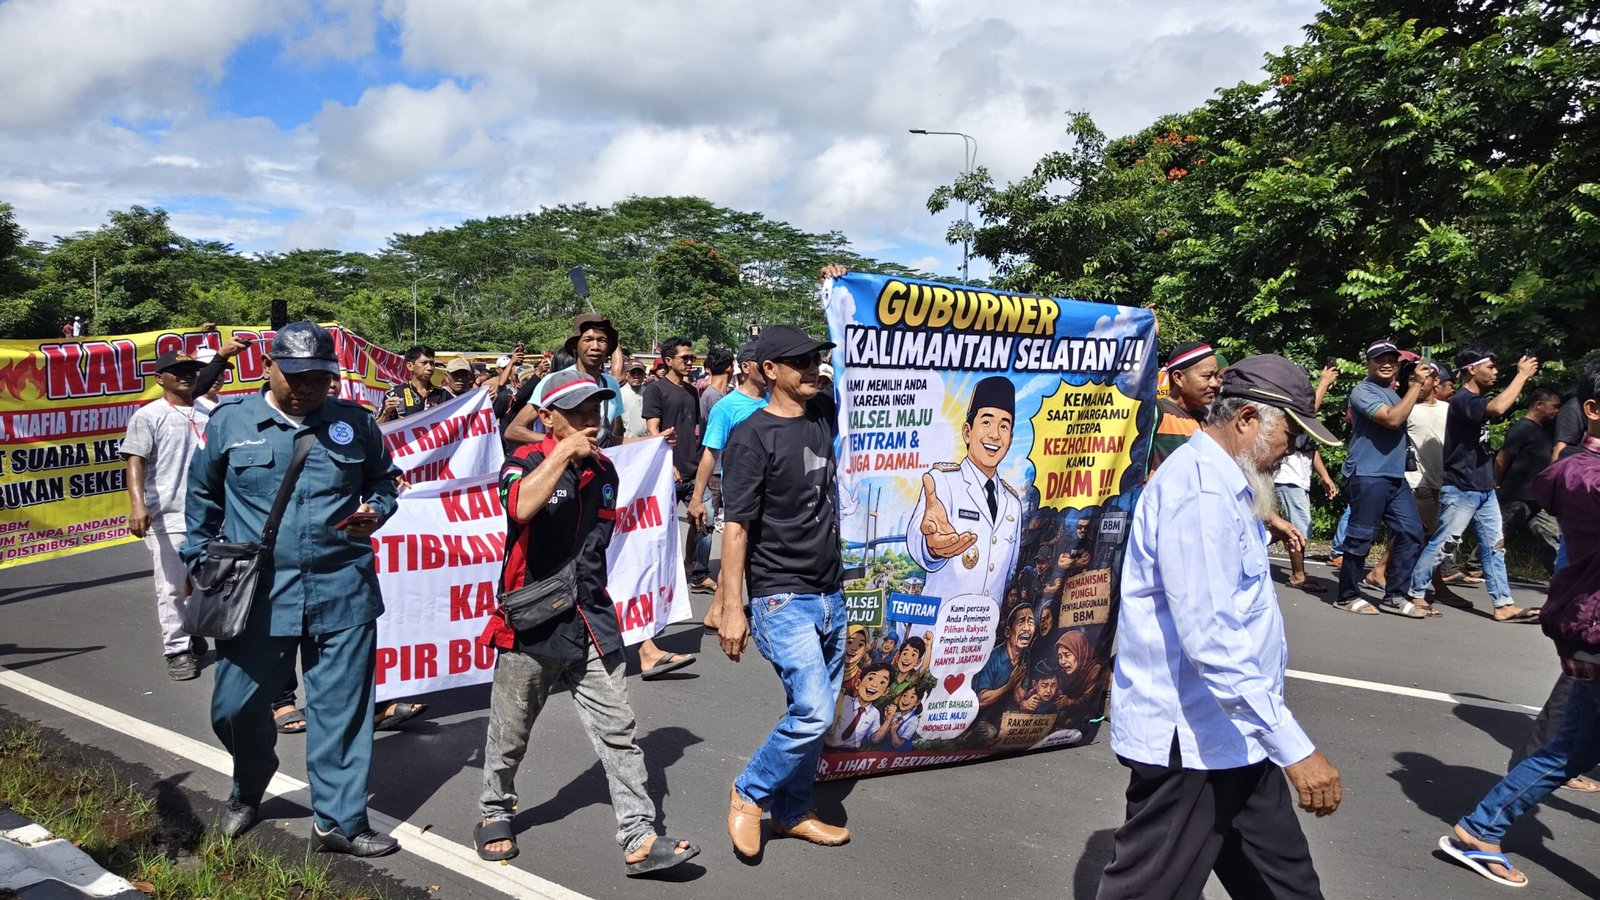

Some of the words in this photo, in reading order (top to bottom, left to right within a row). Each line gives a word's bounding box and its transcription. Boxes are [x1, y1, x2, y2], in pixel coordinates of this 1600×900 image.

[877, 280, 1060, 335] GUBURNER
[845, 328, 1013, 369] KALIMANTAN
[1014, 336, 1118, 371] SELATAN
[866, 379, 902, 391] MEMILIH
[904, 379, 927, 391] ANDA
[853, 394, 890, 407] KARENA
[892, 394, 916, 406] INGIN
[1063, 392, 1114, 407] KEMANA
[848, 410, 892, 429] KALSEL
[896, 408, 933, 427] MAJU
[1047, 409, 1075, 421] SAAT
[1077, 409, 1130, 420] WARGAMU
[13, 411, 67, 439] MAFIA
[1066, 422, 1101, 435] DITERPA
[849, 431, 907, 453] TENTRAM
[909, 430, 920, 449] &
[1043, 436, 1125, 456] KEZHOLIMAN
[11, 443, 91, 474] SUARA
[874, 452, 929, 472] DAMAI...
[1065, 456, 1096, 468] KAMU
[1045, 470, 1093, 500] DIAM
[1098, 468, 1116, 497] !!!
[0, 520, 30, 533] BBM
[20, 528, 63, 543] TANPA
[67, 516, 126, 534] PANDANG
[1102, 520, 1121, 531] BBM
[7, 540, 79, 559] DISTRIBUSI
[1065, 573, 1108, 592] PREMANISME
[1070, 587, 1097, 600] PUNGLI
[892, 601, 936, 617] TENTRAM
[1061, 598, 1109, 612] PENYALAHGUNAAN
[946, 615, 962, 623] Anda
[963, 615, 990, 623] Pemimpin
[1073, 610, 1094, 622] BBM
[966, 625, 988, 634] Rakyat,
[940, 635, 967, 645] Pimpinlah
[969, 635, 989, 643] dengan
[944, 647, 960, 655] HATI,
[961, 645, 982, 654] BUKAN
[934, 657, 955, 666] HANYA
[956, 655, 983, 665] JABATAN
[928, 701, 947, 710] RAKYAT
[948, 700, 973, 709] BAHAGIA
[927, 712, 949, 721] KALSEL
[950, 711, 967, 720] MAJU
[1007, 718, 1033, 727] RAKYAT
[1033, 718, 1050, 726] KECIL
[922, 723, 951, 732] INDONESIA
[952, 722, 966, 731] JAYA
[835, 757, 877, 772] LIHAT
[876, 757, 888, 769] &
